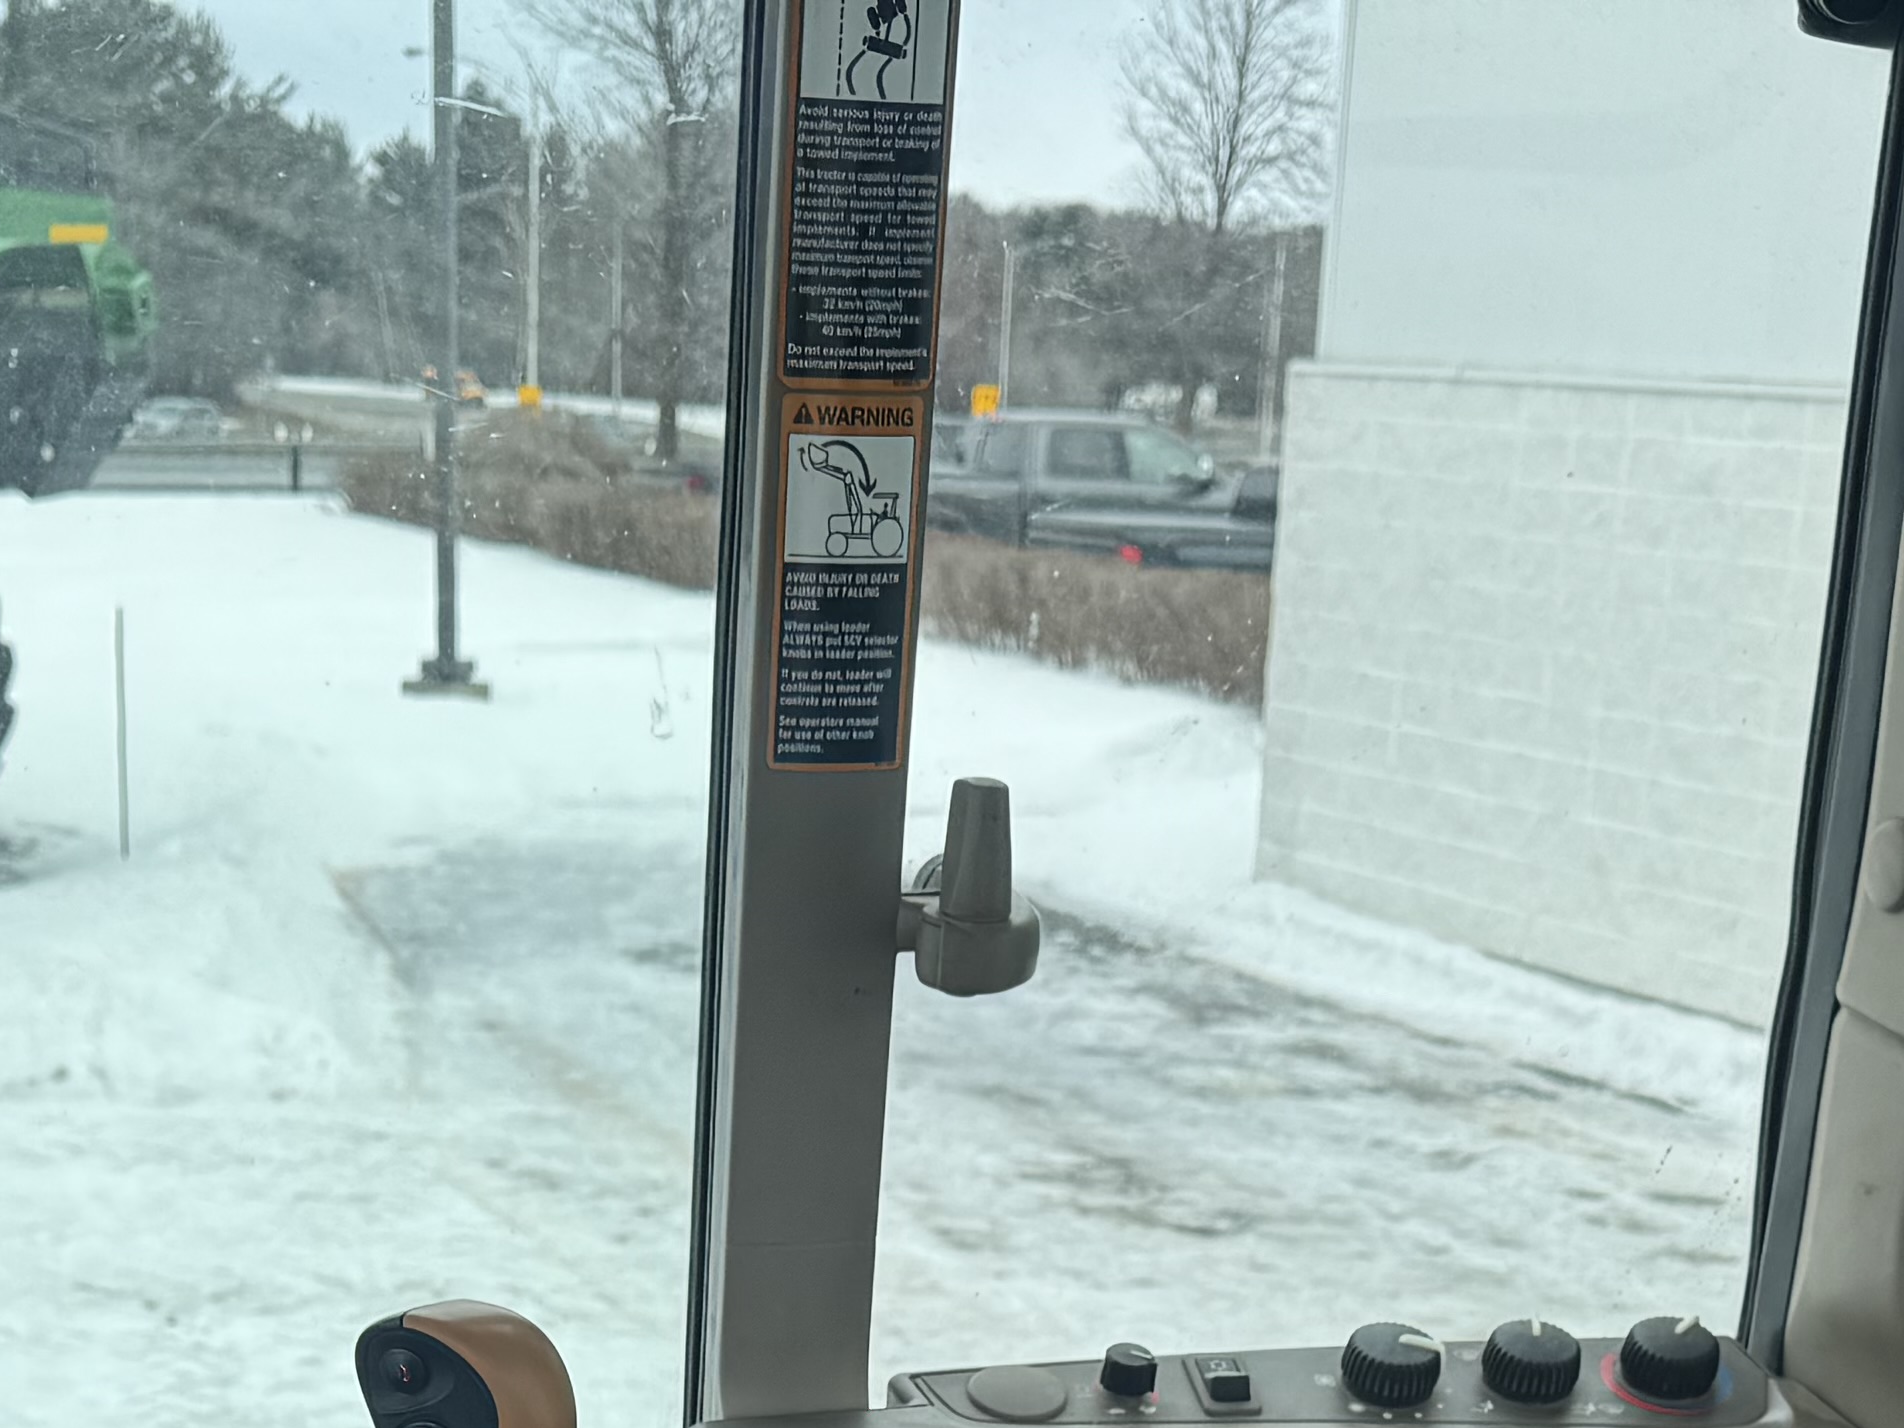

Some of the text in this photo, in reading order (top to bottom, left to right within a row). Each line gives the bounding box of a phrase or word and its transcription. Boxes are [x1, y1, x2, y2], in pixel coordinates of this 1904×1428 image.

[848, 121, 870, 132] from
[834, 136, 879, 149] transport
[809, 182, 856, 197] transport
[794, 211, 844, 224] transport
[788, 343, 801, 354] Do
[817, 406, 913, 426] WARNING
